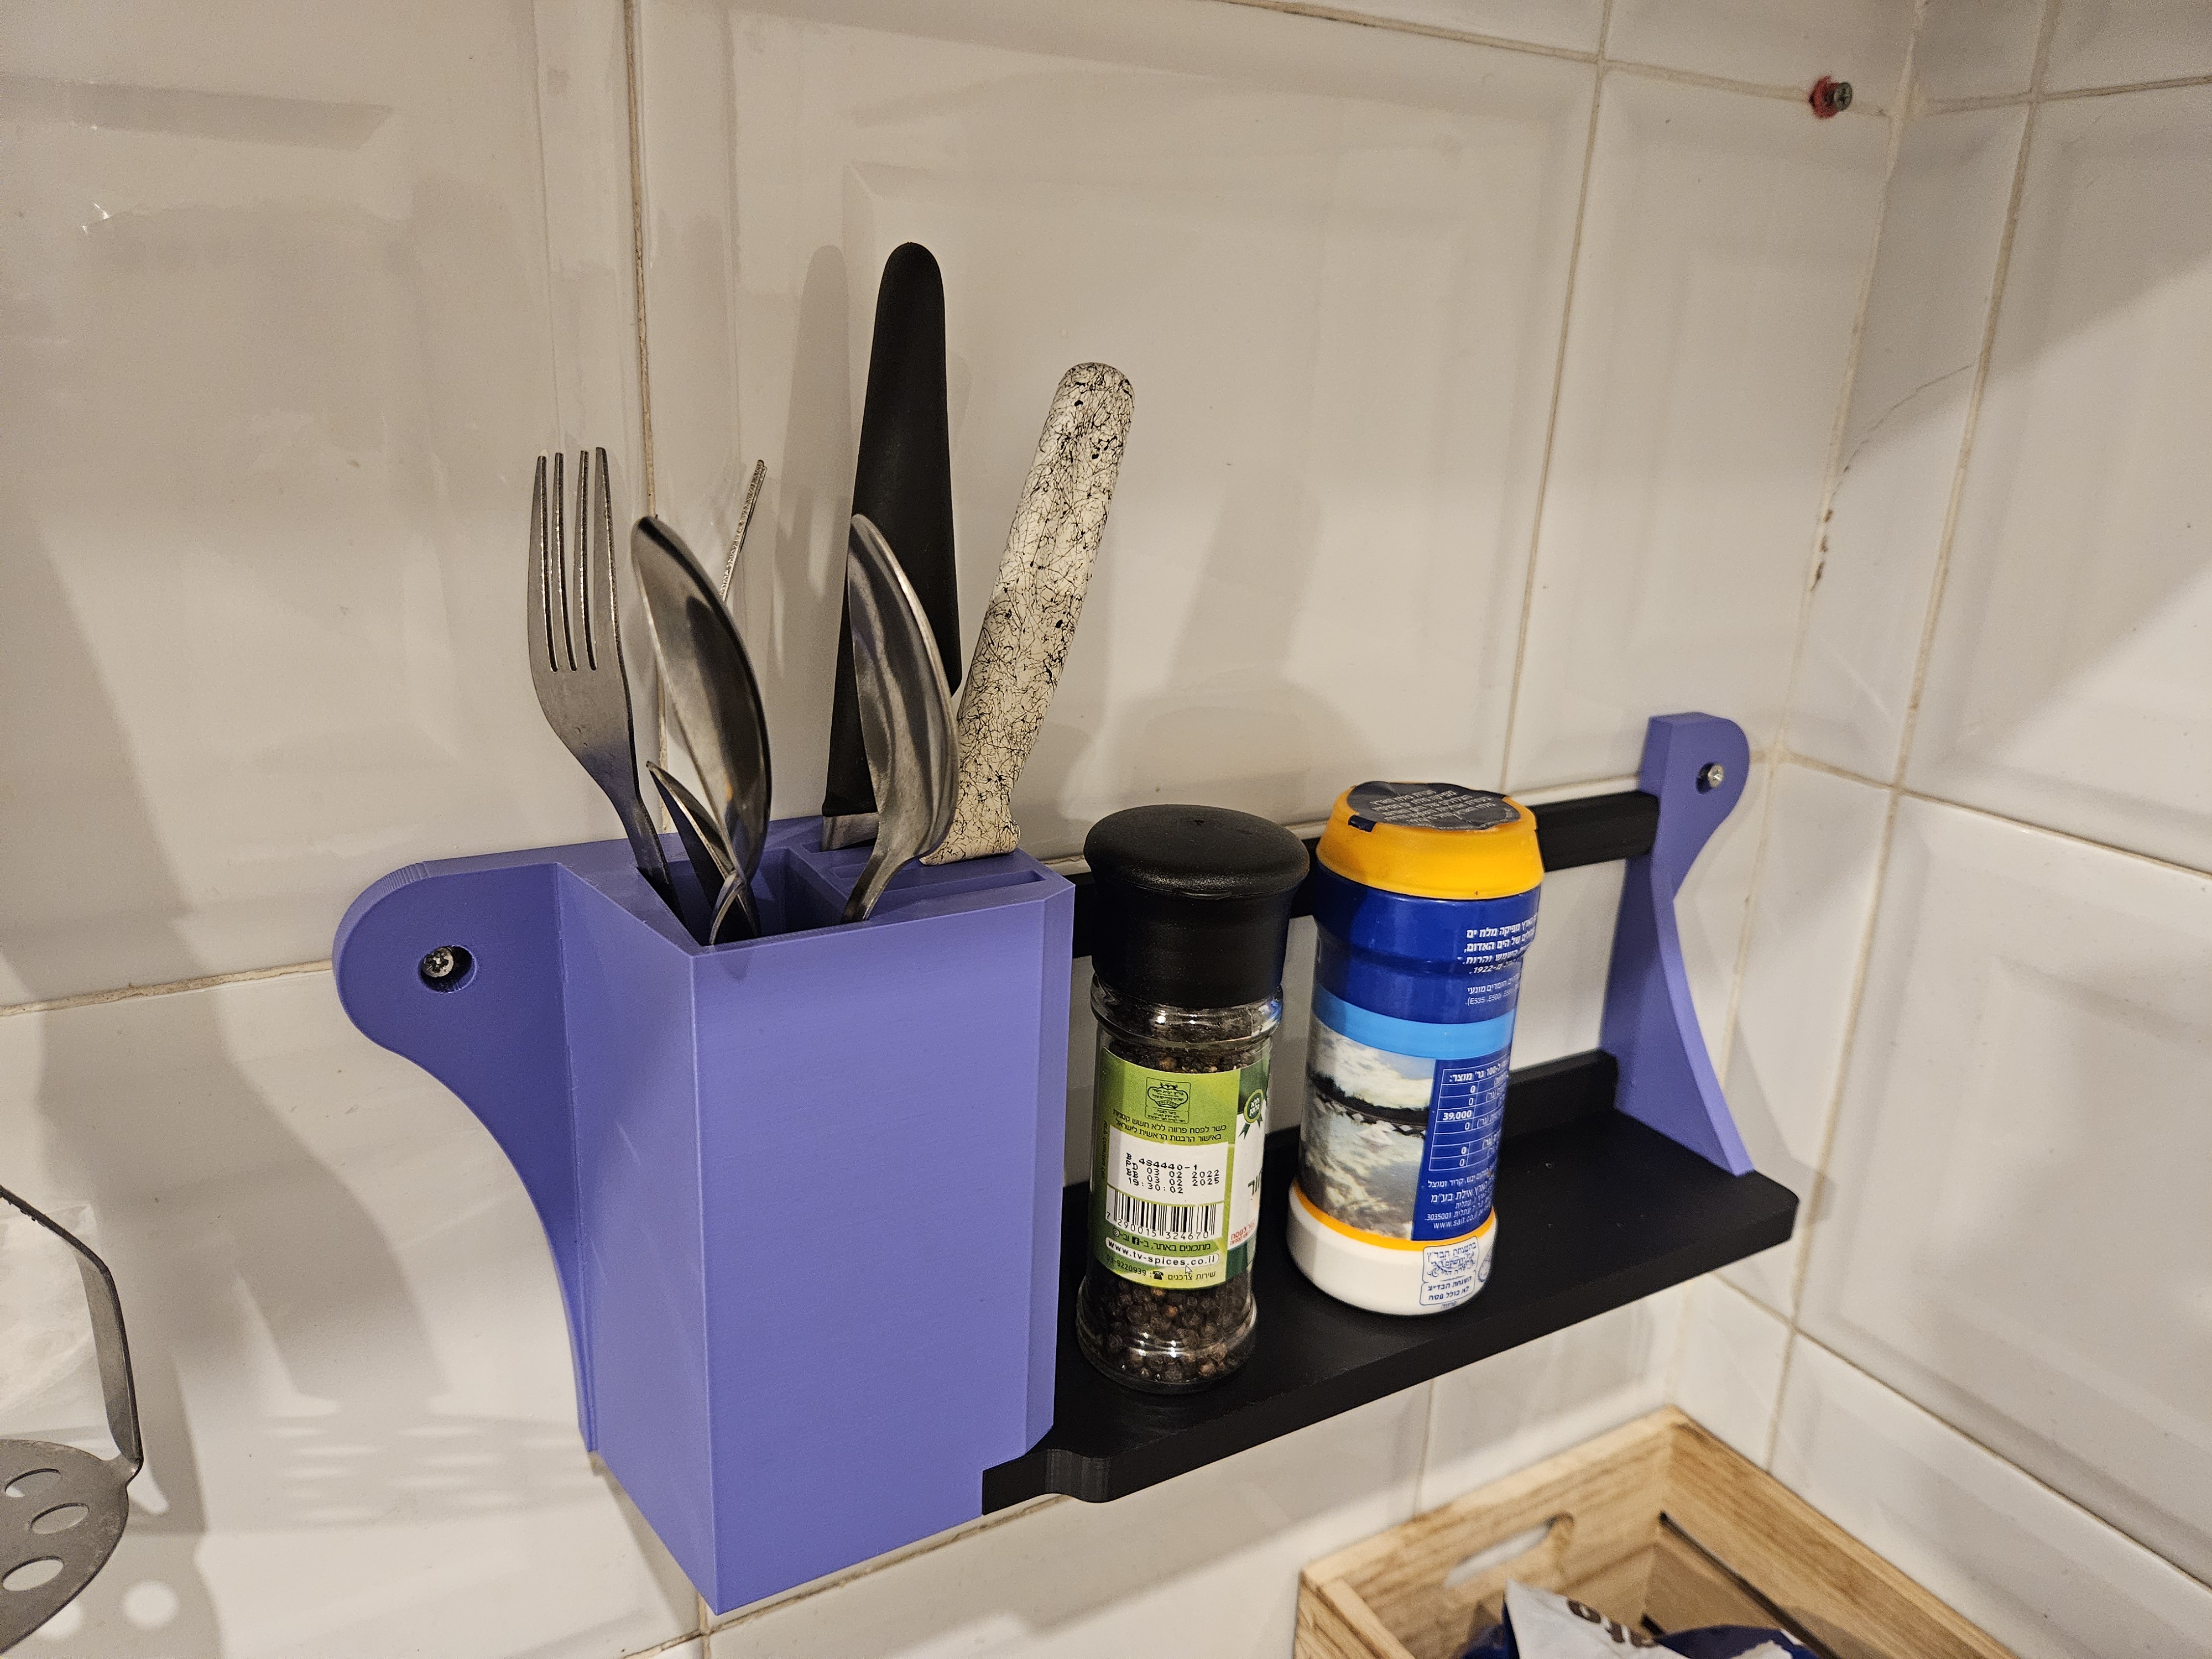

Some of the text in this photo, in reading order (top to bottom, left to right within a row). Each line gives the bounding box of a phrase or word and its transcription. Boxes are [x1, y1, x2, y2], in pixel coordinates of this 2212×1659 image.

[1466, 929, 1477, 938] ים
[1479, 927, 1497, 938] מלח
[1499, 923, 1520, 937] מפיקה
[1496, 939, 1510, 949] הים
[1511, 936, 1521, 945] של
[1464, 942, 1495, 953] האדום,
[1463, 955, 1493, 964] והרוח.
[1467, 985, 1486, 995] מונעי
[1449, 1072, 1473, 1082] מוצר:
[1468, 1097, 1474, 1105] 0
[1112, 1109, 1130, 1123] קטניות
[1442, 1110, 1472, 1121] 39,000
[1115, 1118, 1138, 1133] לישראל
[1132, 1118, 1150, 1129] חשש
[1151, 1123, 1166, 1131] ללא
[1139, 1129, 1167, 1140] הראשית
[1461, 1146, 1467, 1155] 0
[1459, 1158, 1464, 1166] 0
[1126, 1160, 1139, 1171] PD
[1147, 1167, 1160, 1176] 03
[1192, 1170, 1219, 1178] 2022
[1147, 1175, 1160, 1183] 03
[1192, 1177, 1220, 1186] 2025
[1449, 1178, 1464, 1186] קריר
[1106, 1211, 1111, 1219] 7
[1151, 1242, 1177, 1251] באתר,
[1180, 1243, 1211, 1251] מתכונים
[1108, 1239, 1215, 1265] www.tv-spices.co.il
[1196, 1271, 1216, 1280] שירות
[1446, 1290, 1460, 1298] כולל
[1461, 1286, 1469, 1294] לא
